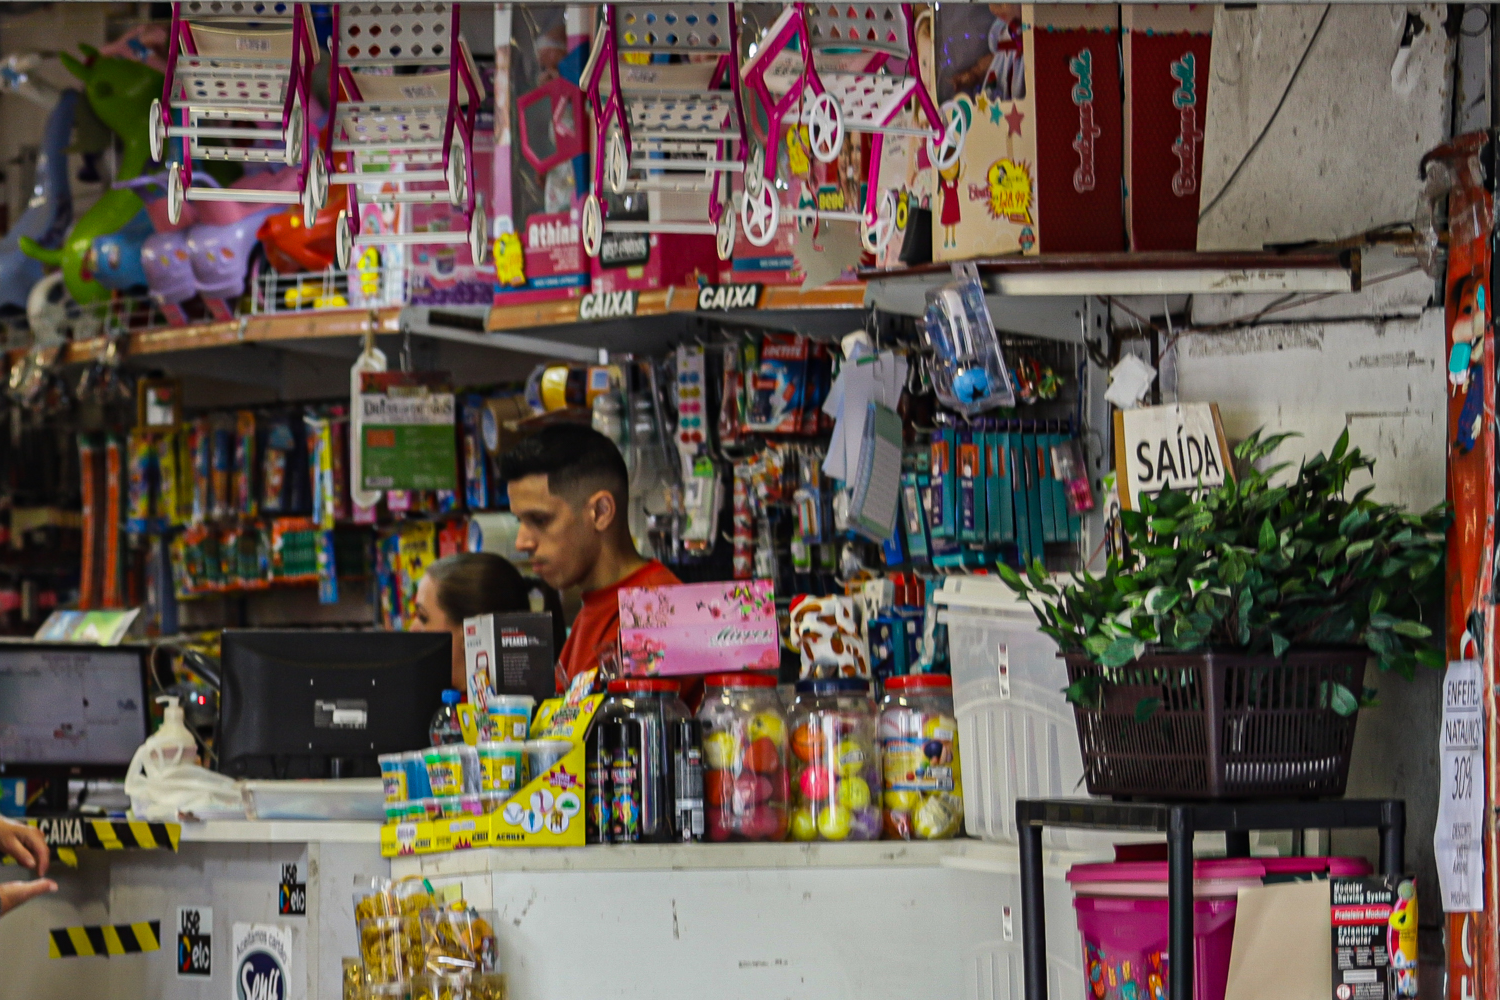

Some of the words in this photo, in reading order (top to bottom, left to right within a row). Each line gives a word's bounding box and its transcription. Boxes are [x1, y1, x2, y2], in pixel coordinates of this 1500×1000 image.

[581, 291, 634, 319] CAIXA
[699, 284, 758, 310] CAIXA
[1136, 424, 1220, 483] SAÍDA
[40, 817, 84, 845] CAIXA
[281, 862, 297, 884] use
[290, 888, 305, 912] elo
[181, 909, 201, 935] use
[191, 942, 210, 970] elo
